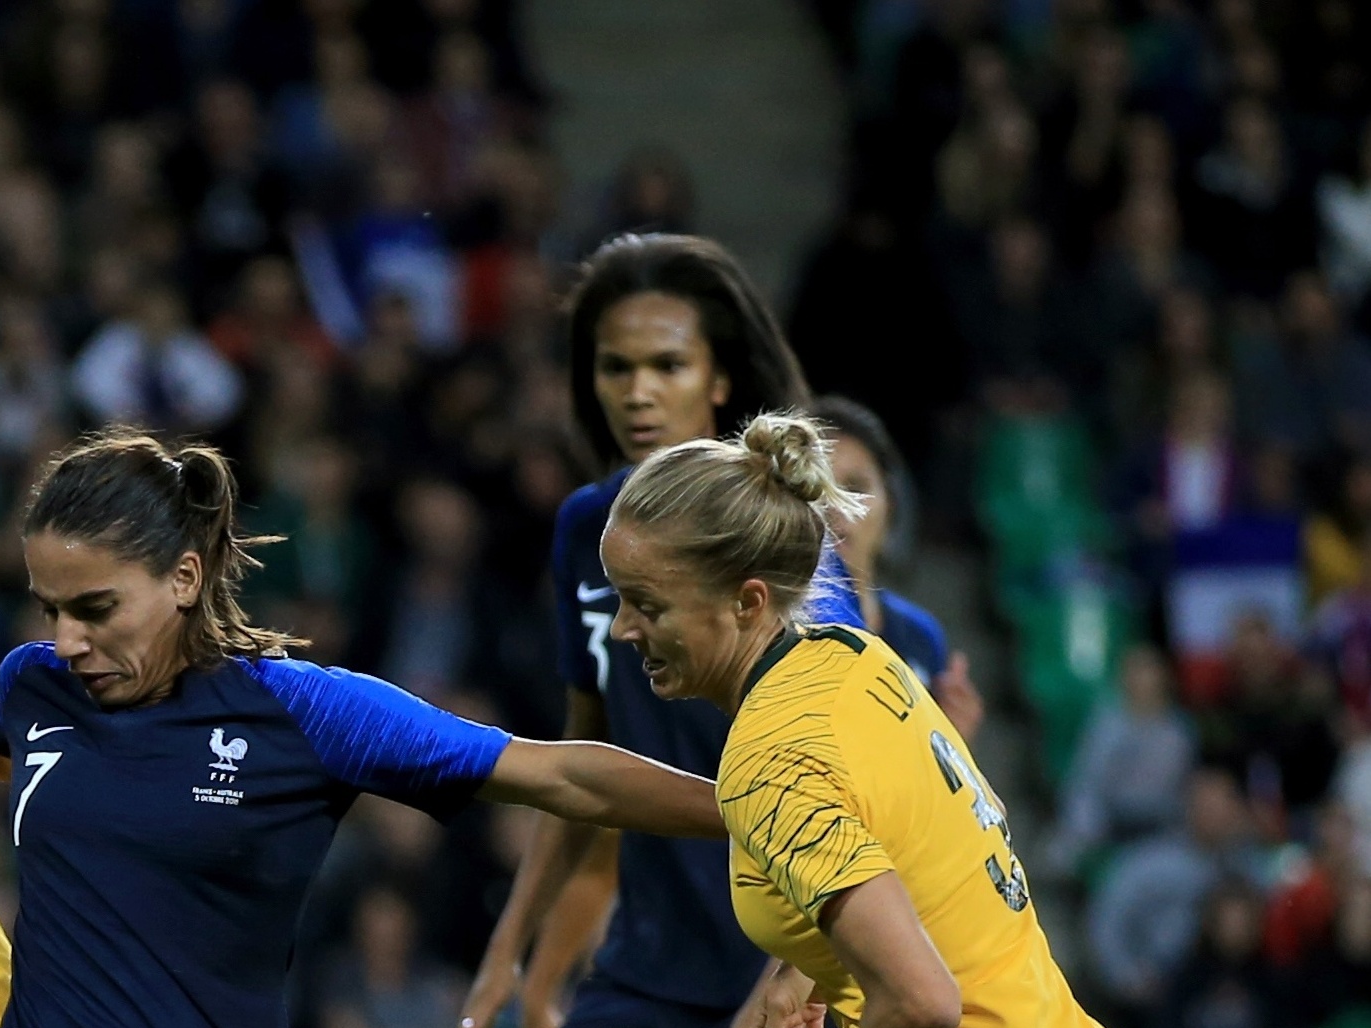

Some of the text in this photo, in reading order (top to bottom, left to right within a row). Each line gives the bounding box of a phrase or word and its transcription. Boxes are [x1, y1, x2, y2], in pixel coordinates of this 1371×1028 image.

[581, 610, 614, 694] 3
[13, 751, 63, 846] 7
[930, 730, 1029, 912] 3
